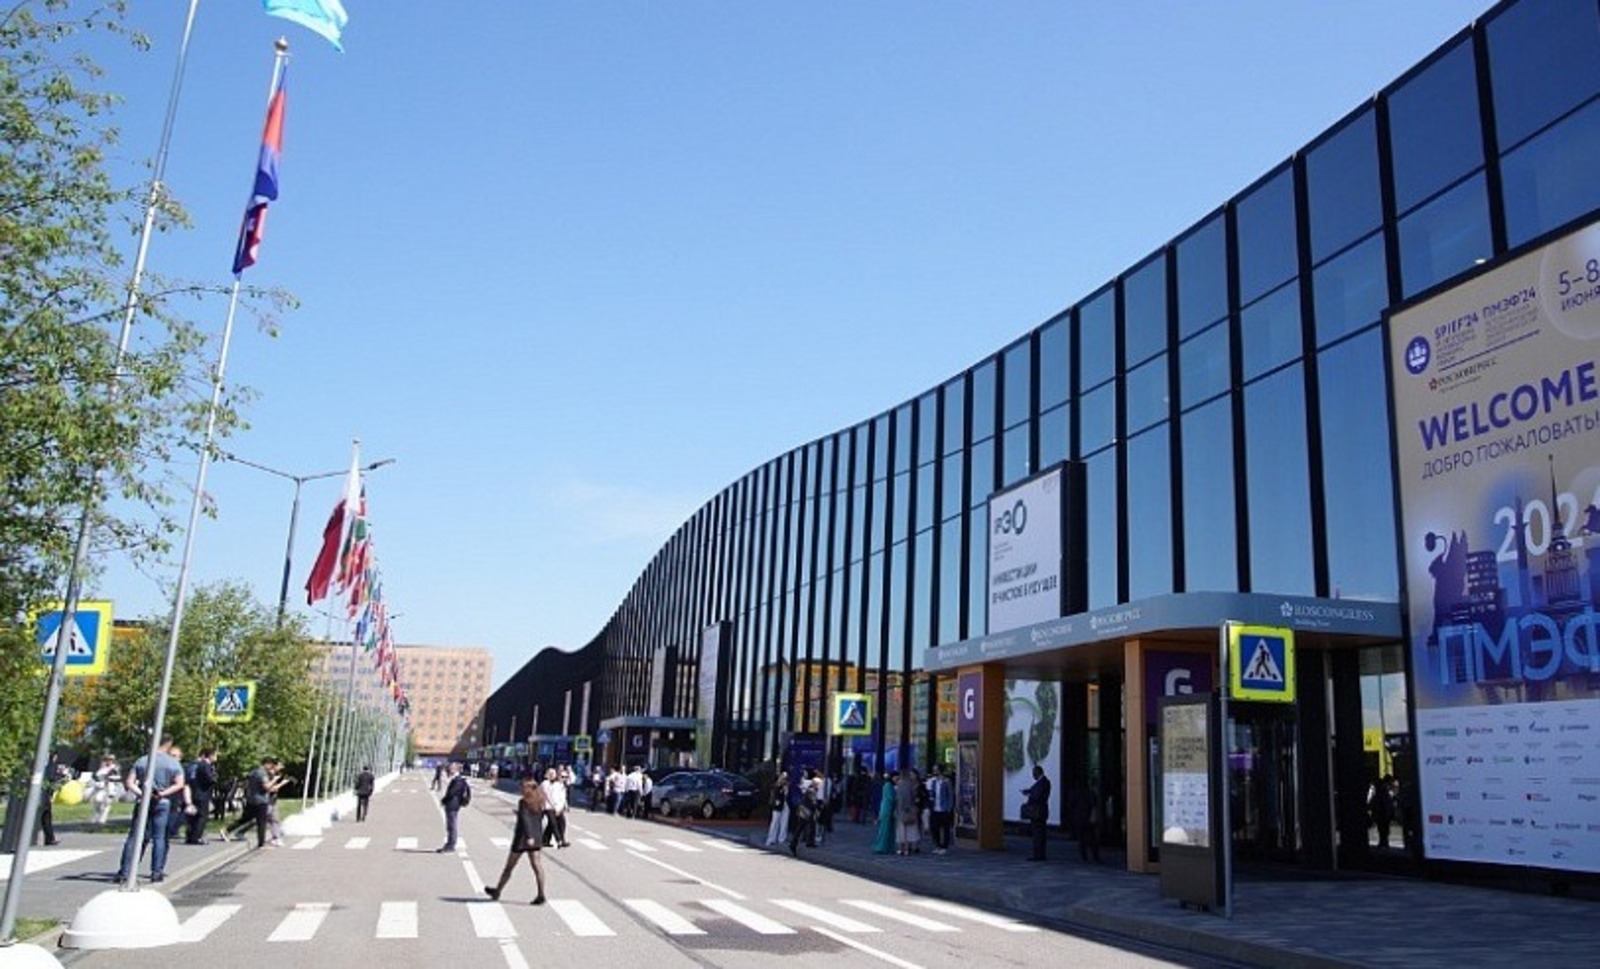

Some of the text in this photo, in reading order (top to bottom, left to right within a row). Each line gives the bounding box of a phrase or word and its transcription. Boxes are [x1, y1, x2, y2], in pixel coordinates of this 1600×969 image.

[1418, 361, 1598, 451] WELCOME
[1422, 450, 1474, 479] ДОБРО
[1437, 605, 1600, 686] ПМЭФ
[1165, 668, 1193, 696] G
[964, 688, 975, 720] G
[632, 734, 643, 748] G
